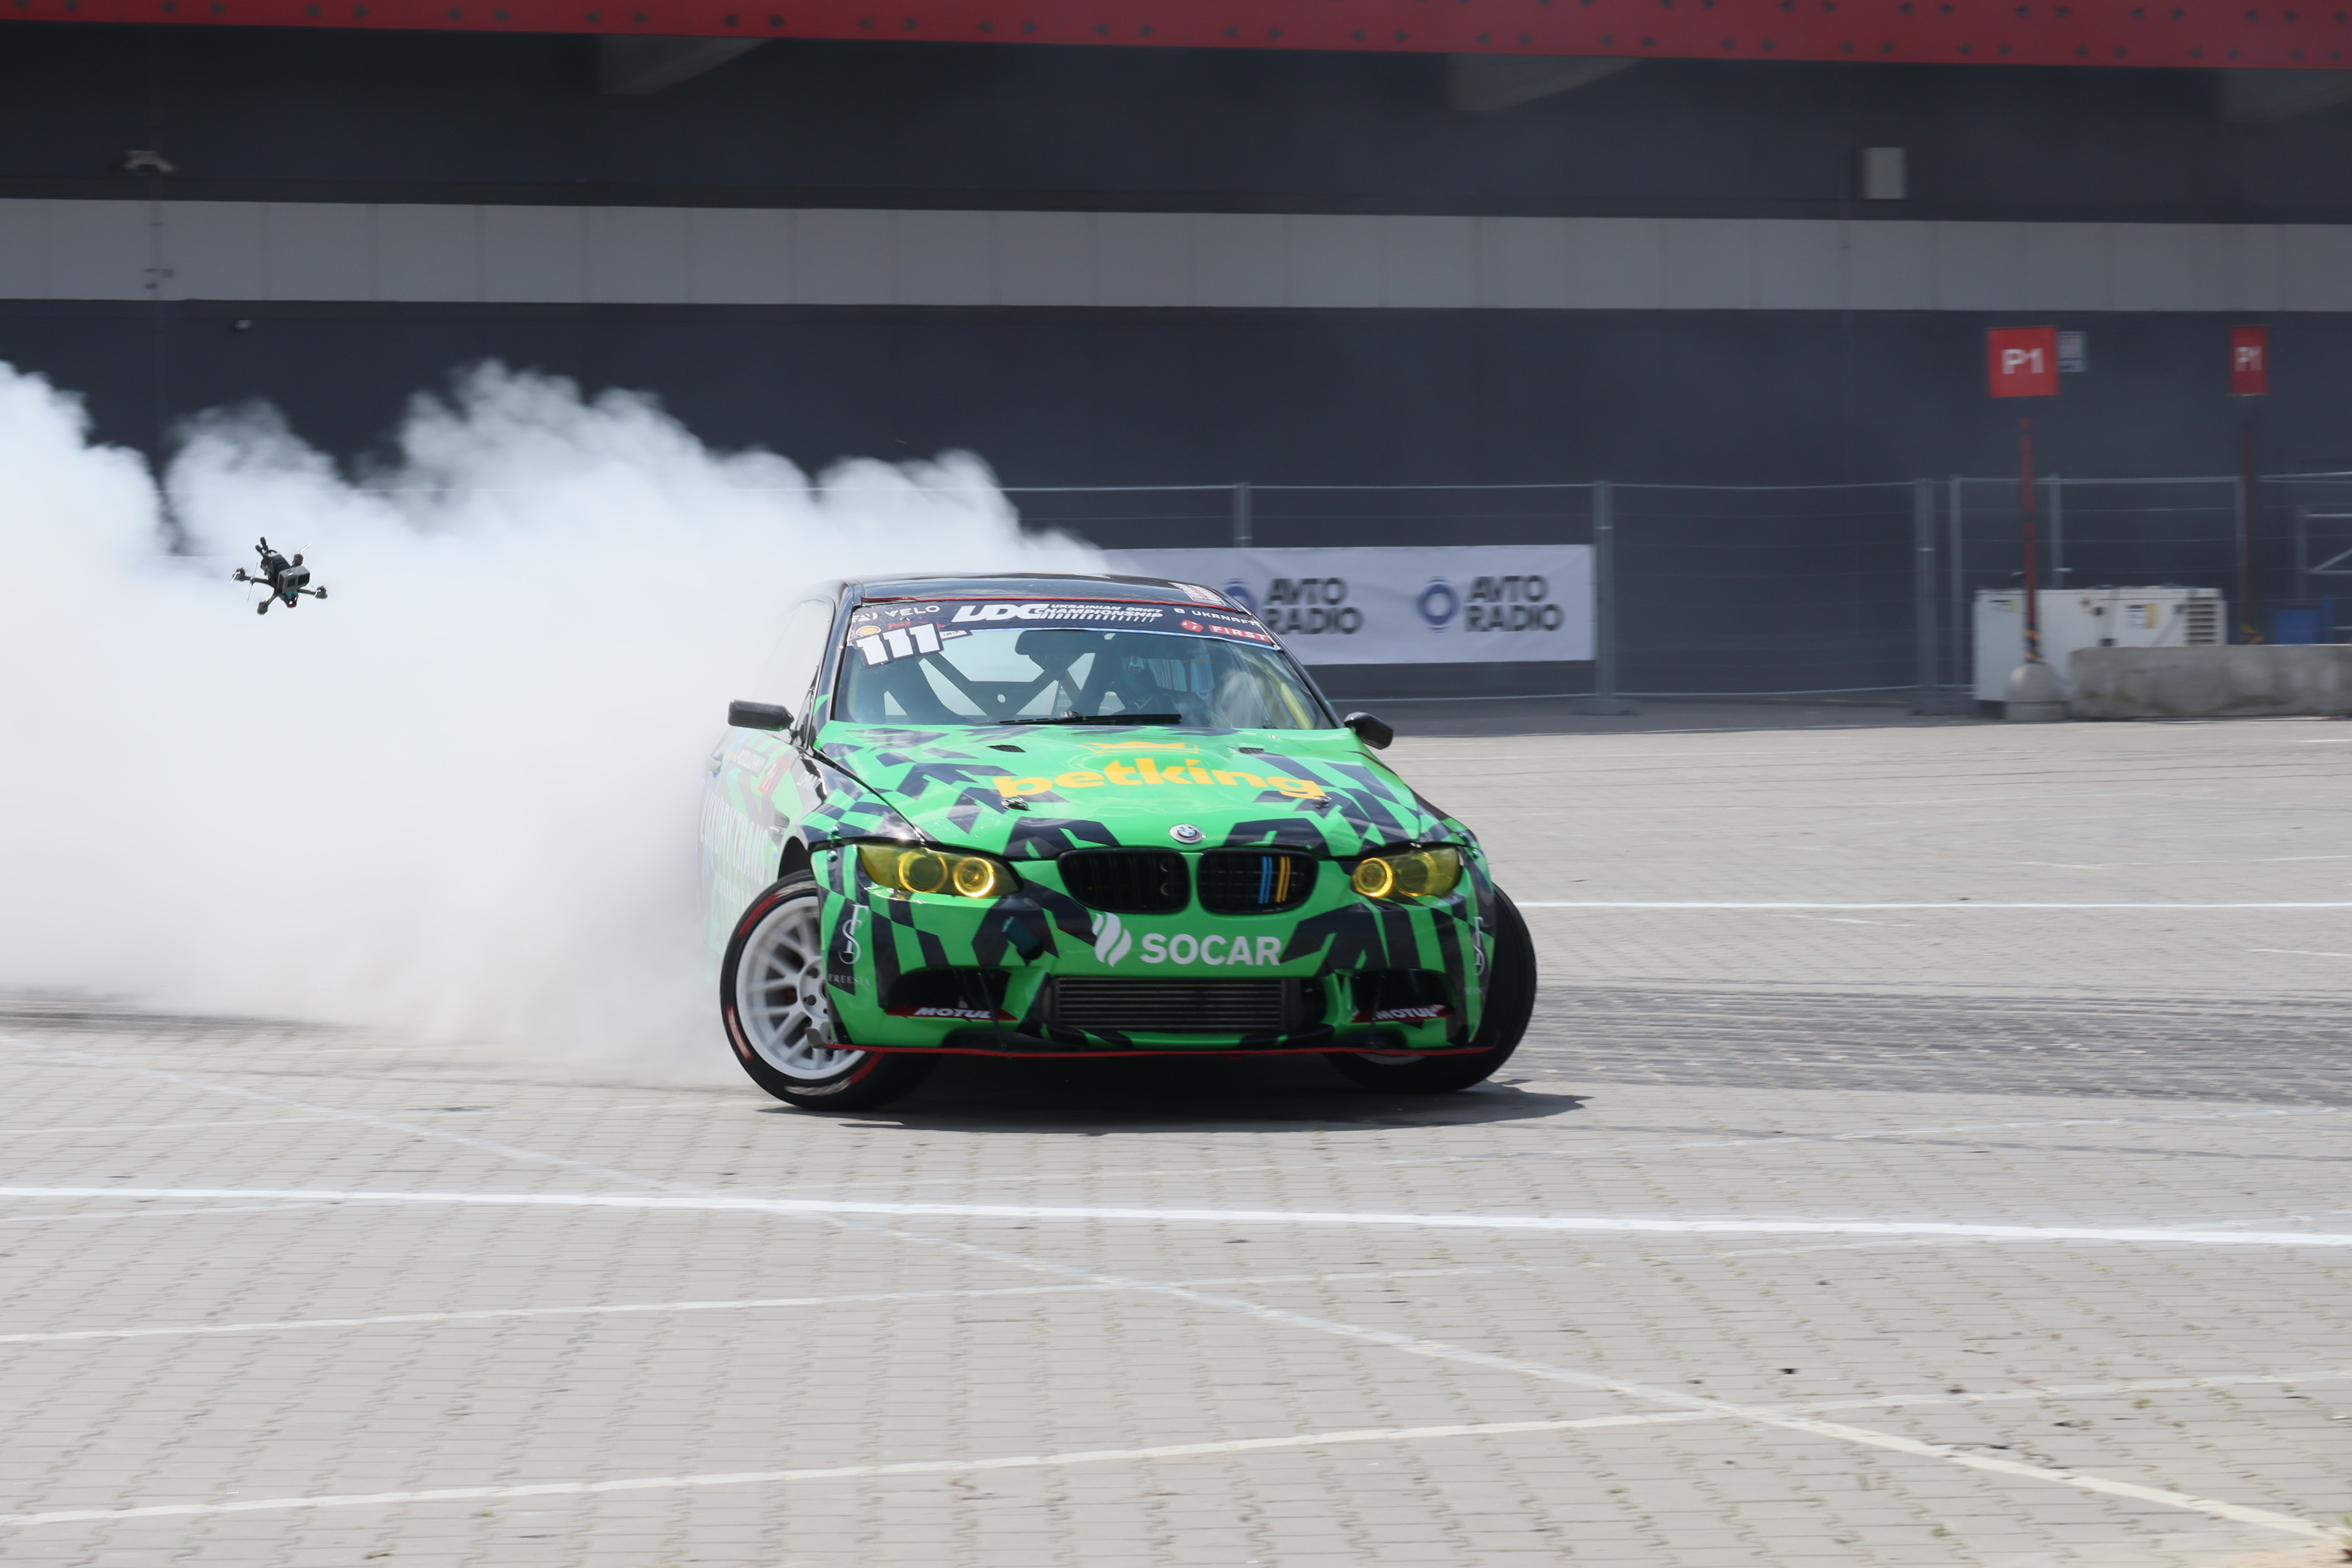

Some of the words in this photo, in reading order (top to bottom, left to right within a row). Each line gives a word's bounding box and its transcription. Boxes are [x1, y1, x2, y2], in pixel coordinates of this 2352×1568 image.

[2001, 348, 2045, 375] P1
[2235, 346, 2262, 372] P1
[1468, 575, 1549, 603] AVTO
[884, 605, 940, 617] VELO
[1034, 608, 1163, 617] CHAMPIONSHIP
[1191, 609, 1261, 626] UKRNAFT
[1262, 607, 1365, 635] RADIO
[1464, 603, 1565, 632] RADIO
[856, 623, 940, 665] 111
[1213, 625, 1266, 640] FIRST
[993, 757, 1327, 799] betking
[1140, 933, 1282, 965] SOCAR
[913, 1007, 994, 1019] MOTUL
[1372, 1008, 1438, 1020] MOTUL
